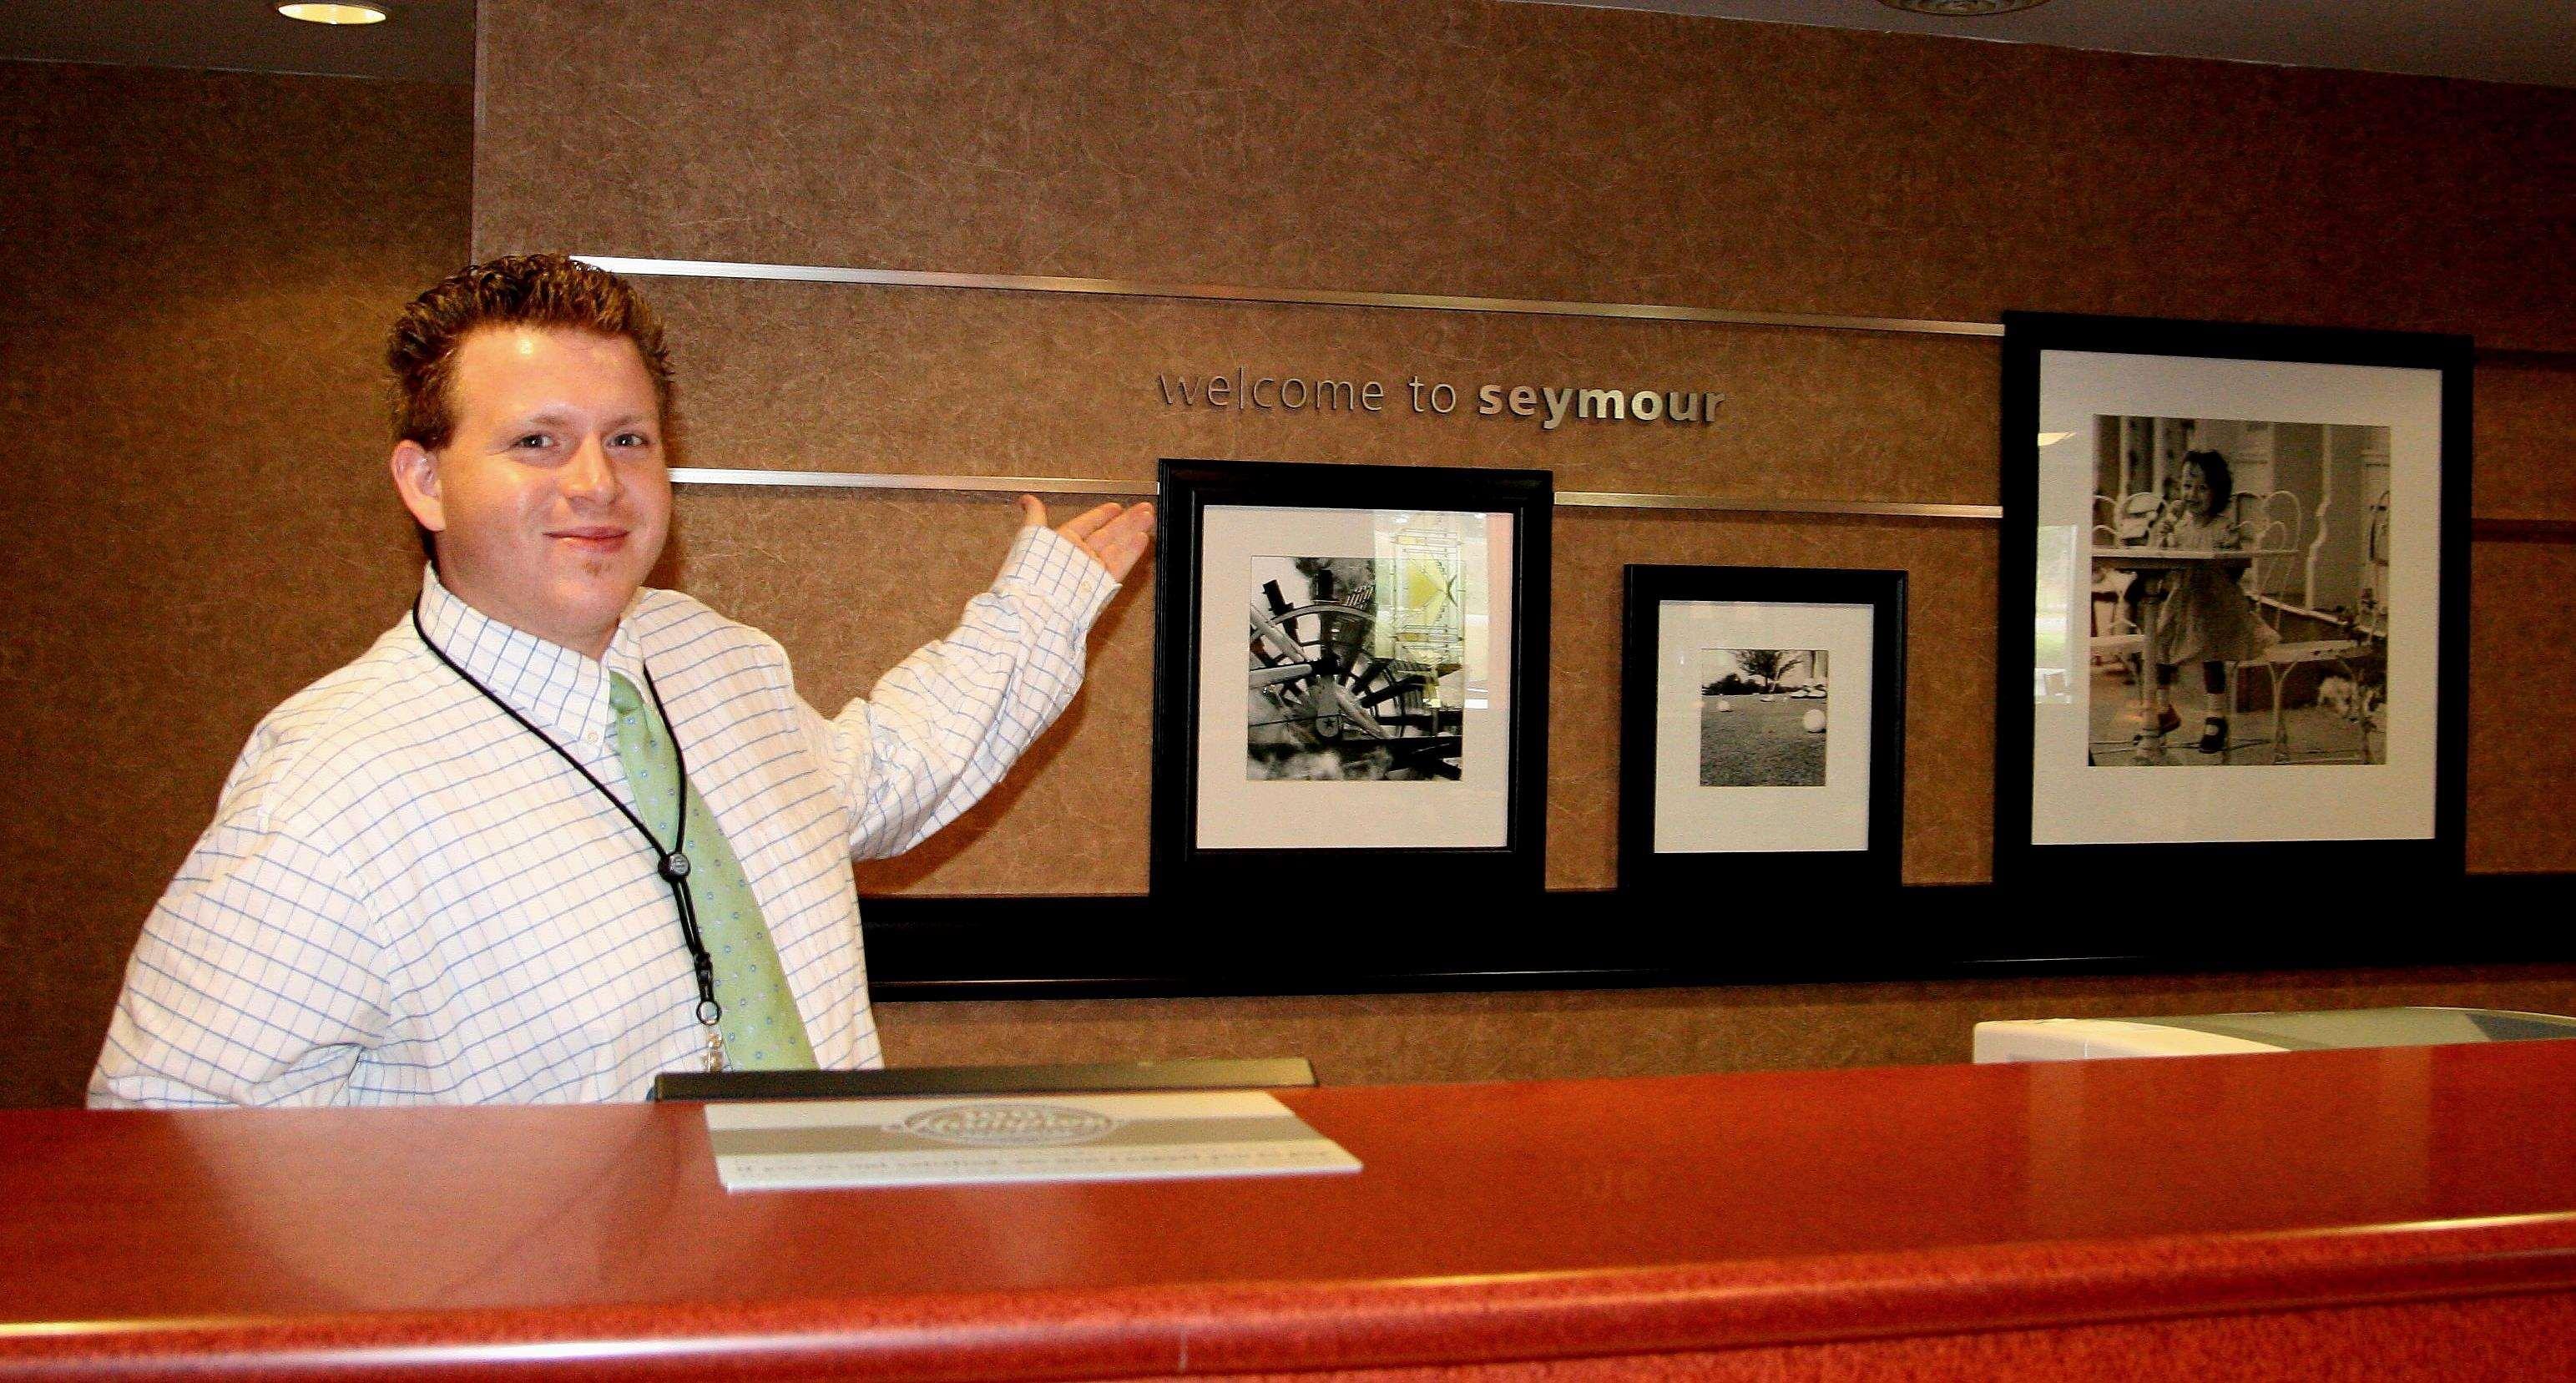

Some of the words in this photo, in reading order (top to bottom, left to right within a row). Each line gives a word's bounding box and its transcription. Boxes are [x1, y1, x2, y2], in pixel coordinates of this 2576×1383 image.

[1159, 366, 1386, 411] welcome
[1408, 375, 1457, 414] to
[1478, 382, 1726, 431] seymour
